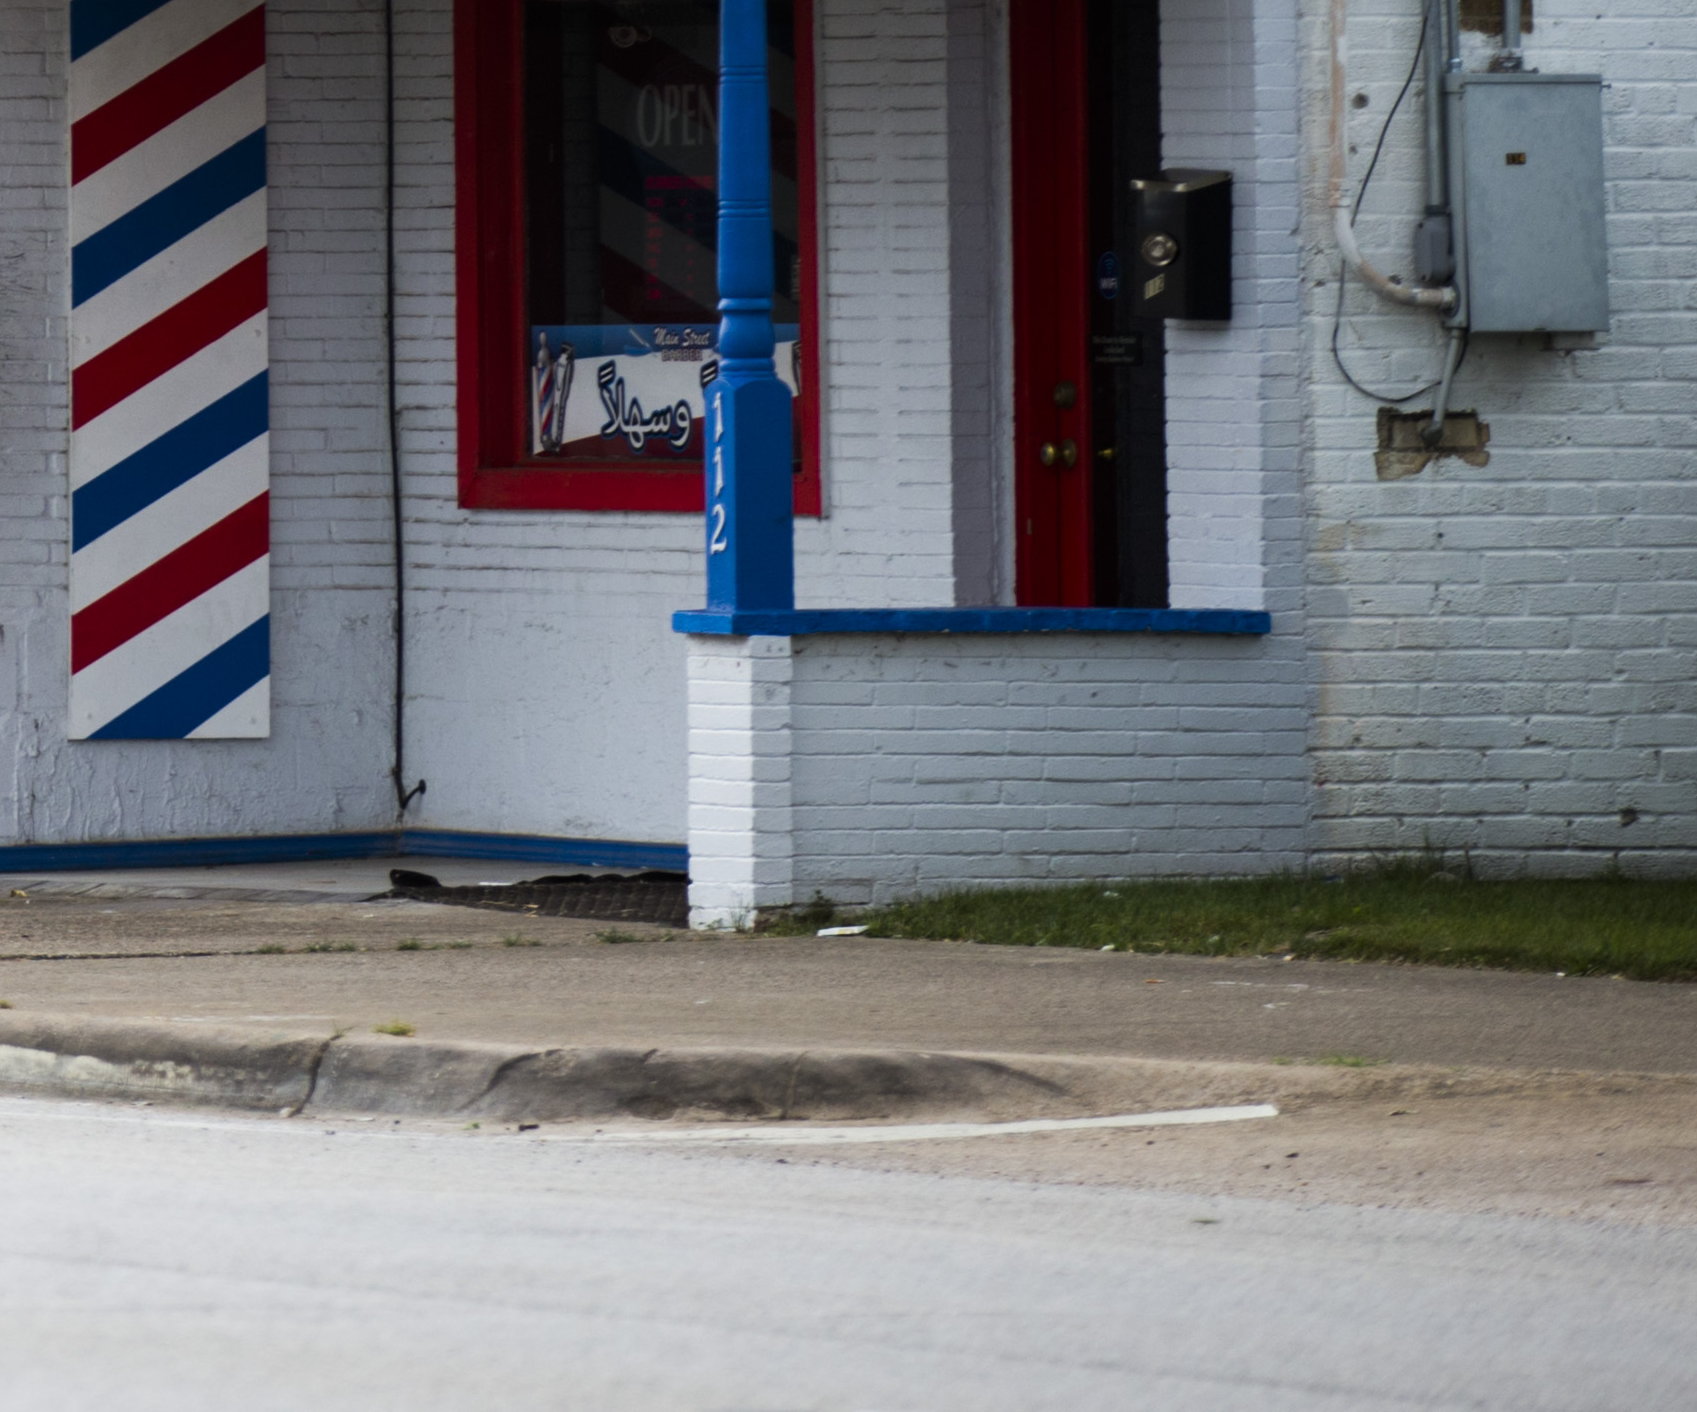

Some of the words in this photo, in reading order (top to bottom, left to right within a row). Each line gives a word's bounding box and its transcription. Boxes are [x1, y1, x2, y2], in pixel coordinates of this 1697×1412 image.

[637, 84, 717, 146] OPEN
[652, 327, 679, 346] Main
[683, 327, 711, 347] Street
[661, 349, 703, 362] BARBER
